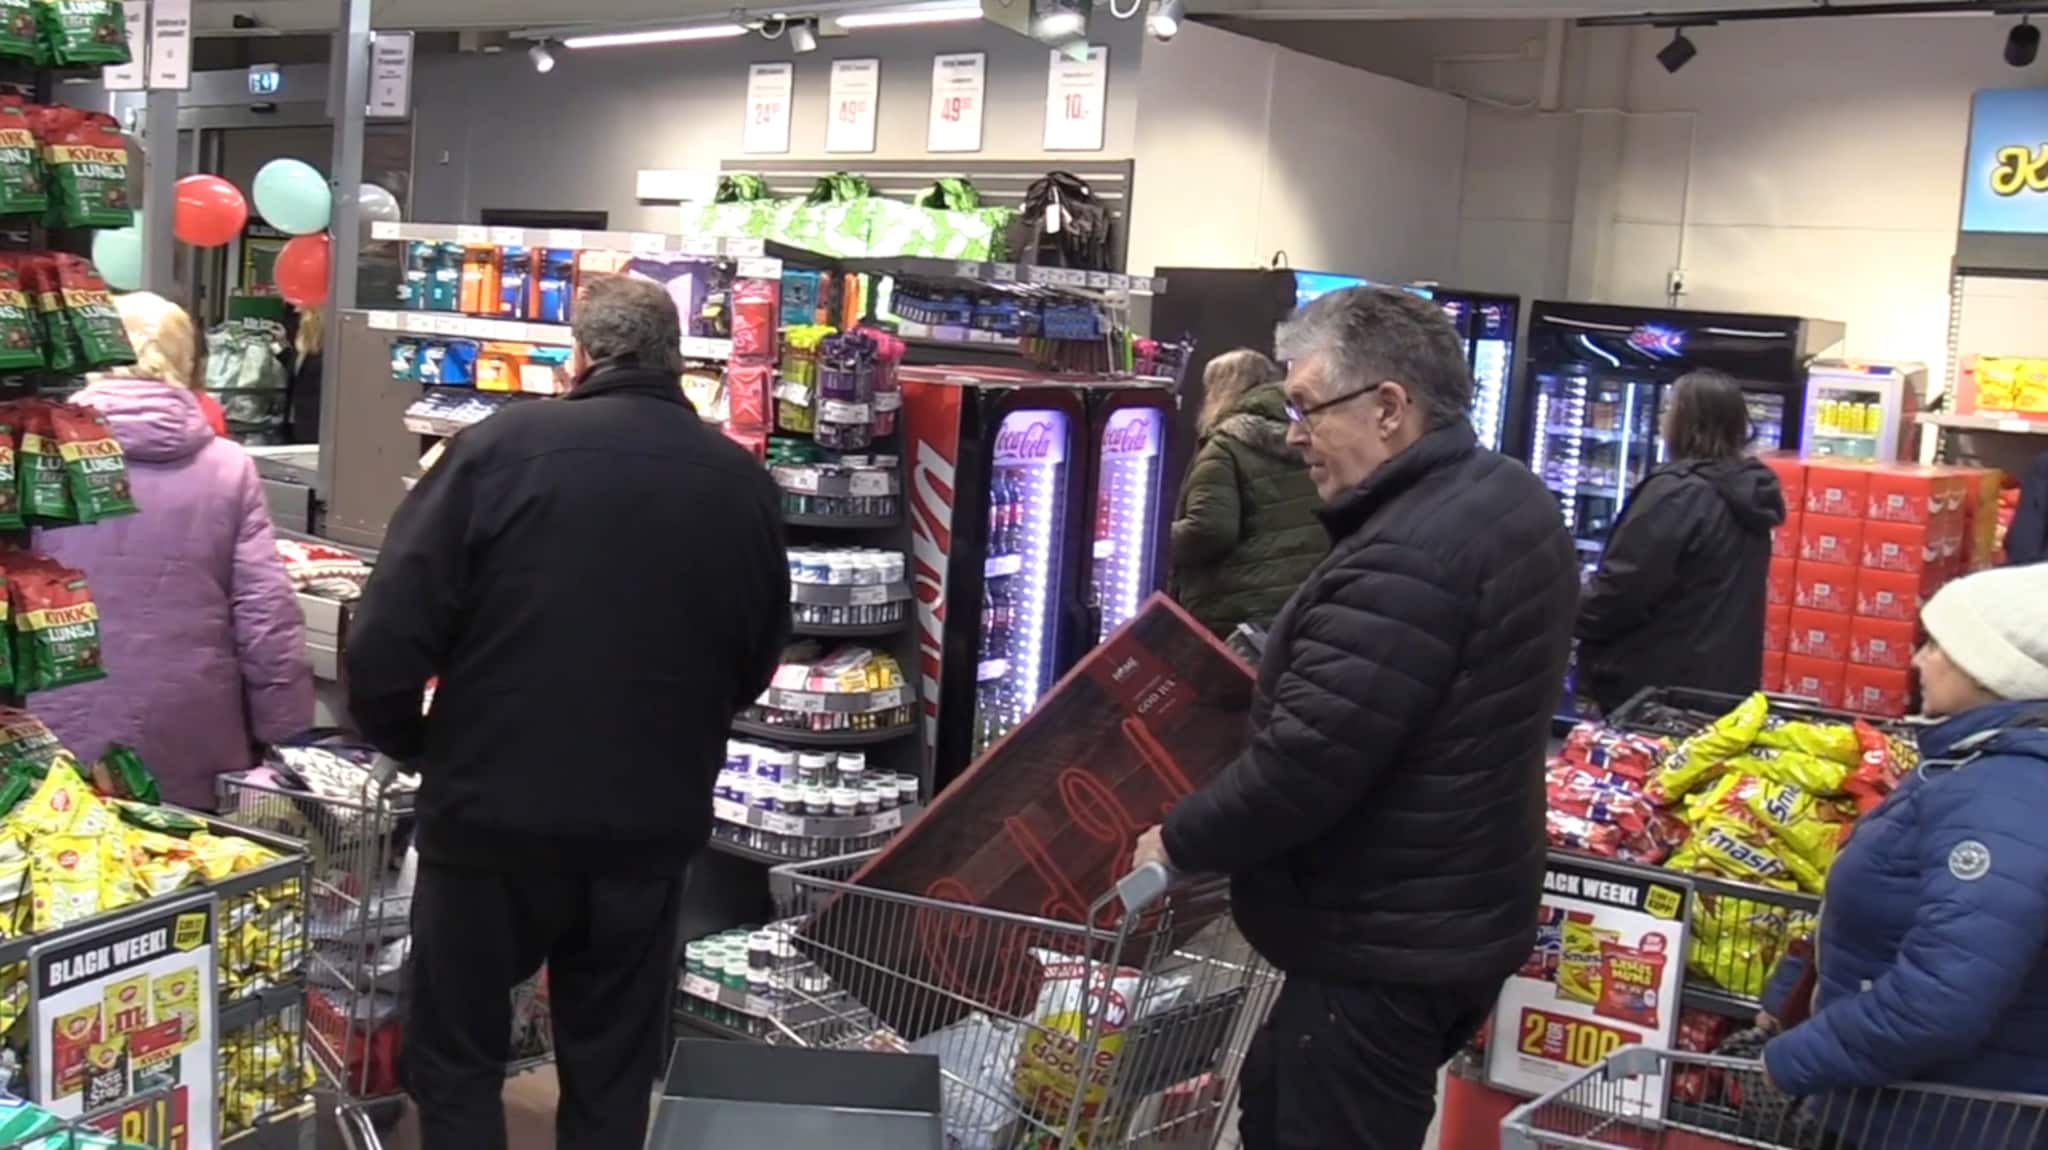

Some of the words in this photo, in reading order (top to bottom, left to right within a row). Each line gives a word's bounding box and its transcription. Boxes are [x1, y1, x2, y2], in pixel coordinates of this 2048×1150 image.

[1543, 871, 1580, 895] ACK
[1582, 877, 1640, 907] WEEK!
[48, 945, 112, 988] BLACK
[111, 927, 168, 967] WEEK!
[1522, 1013, 1547, 1054] 2
[1564, 1022, 1621, 1066] 100
